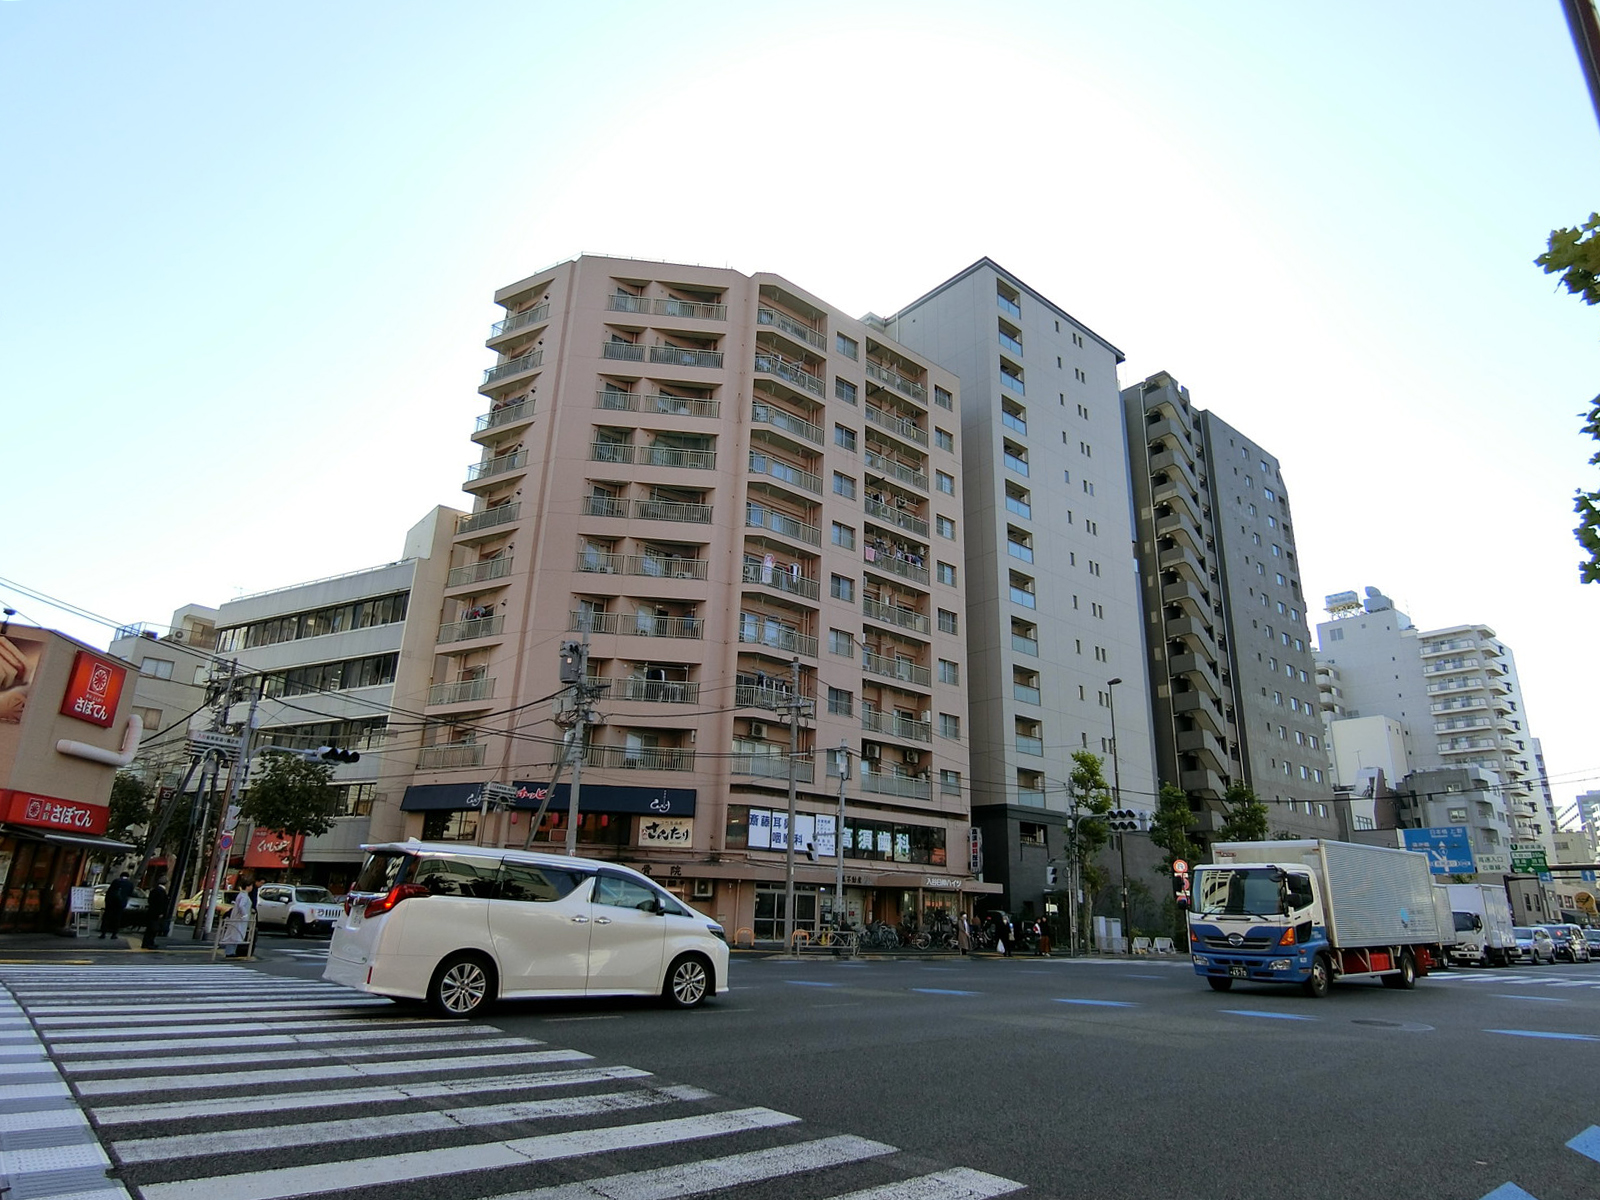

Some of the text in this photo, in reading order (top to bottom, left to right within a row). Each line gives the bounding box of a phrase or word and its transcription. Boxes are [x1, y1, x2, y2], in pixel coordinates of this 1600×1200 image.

[74, 696, 108, 720] さぼてん
[50, 804, 93, 827] さぼてん
